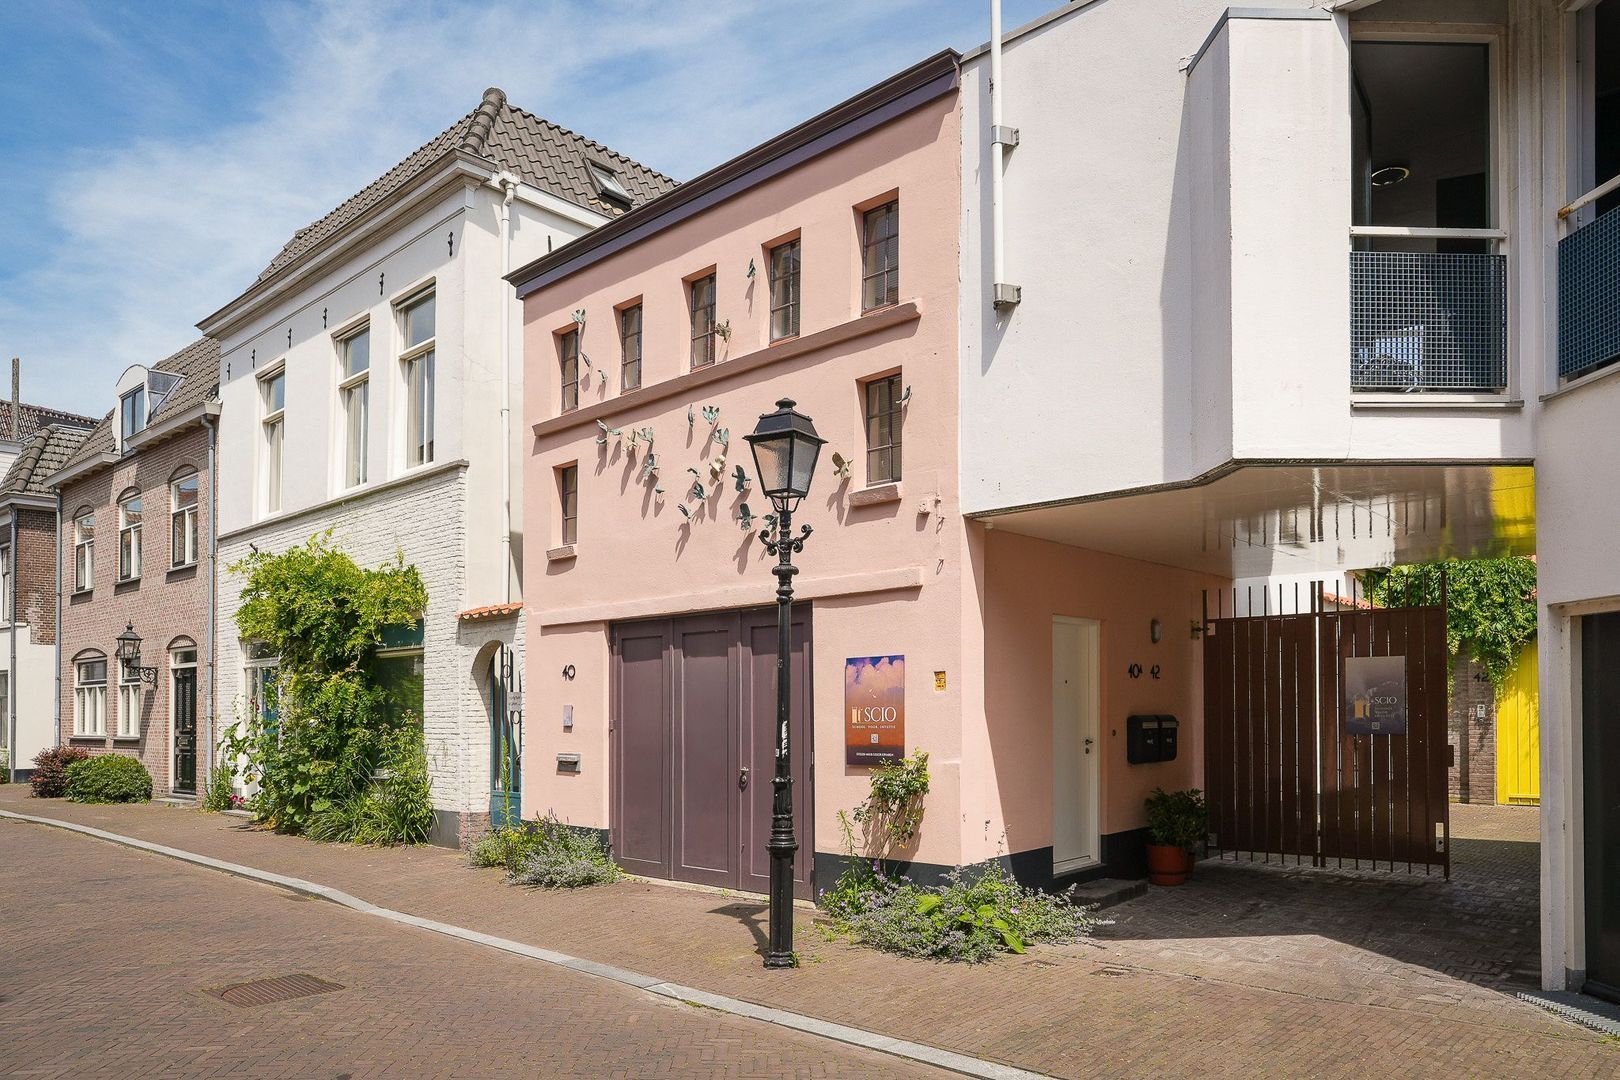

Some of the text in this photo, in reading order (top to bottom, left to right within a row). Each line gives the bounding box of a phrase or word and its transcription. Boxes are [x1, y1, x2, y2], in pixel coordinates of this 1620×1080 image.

[562, 664, 576, 679] 40
[1150, 664, 1161, 679] 42
[1374, 696, 1398, 705] SCIO
[864, 706, 897, 722] SCIO
